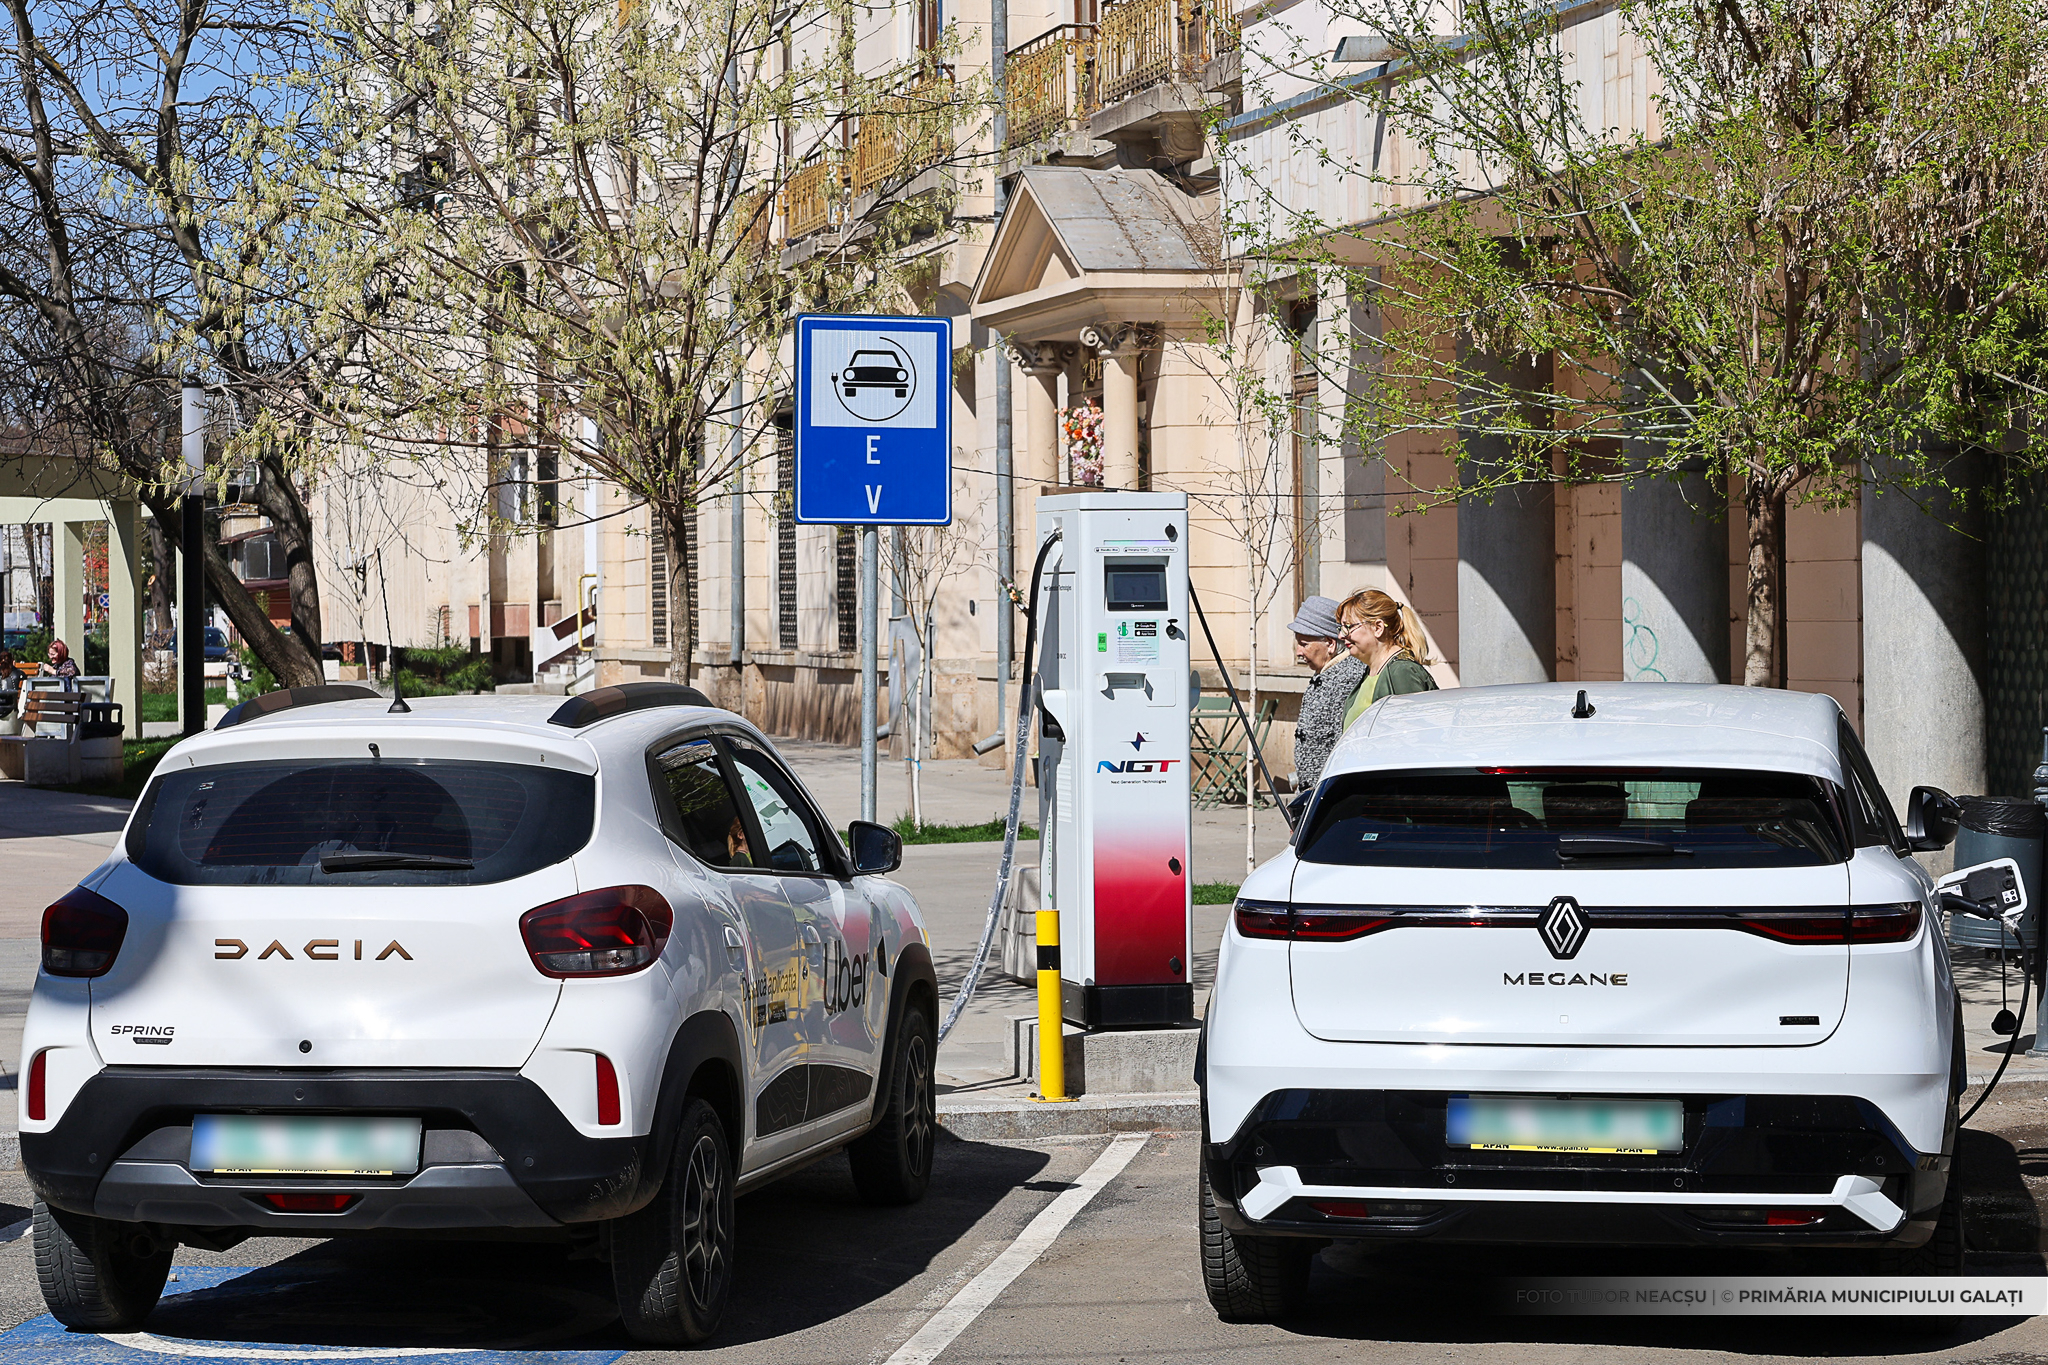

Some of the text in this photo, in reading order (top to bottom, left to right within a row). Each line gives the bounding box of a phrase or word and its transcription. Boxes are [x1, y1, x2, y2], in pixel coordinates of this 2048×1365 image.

[866, 435, 881, 464] E
[865, 485, 882, 514] V
[1097, 760, 1181, 773] NGT
[214, 938, 414, 960] DACIA
[823, 939, 870, 1016] Uber
[1503, 972, 1628, 986] MEGANE
[111, 1025, 175, 1035] SPRING
